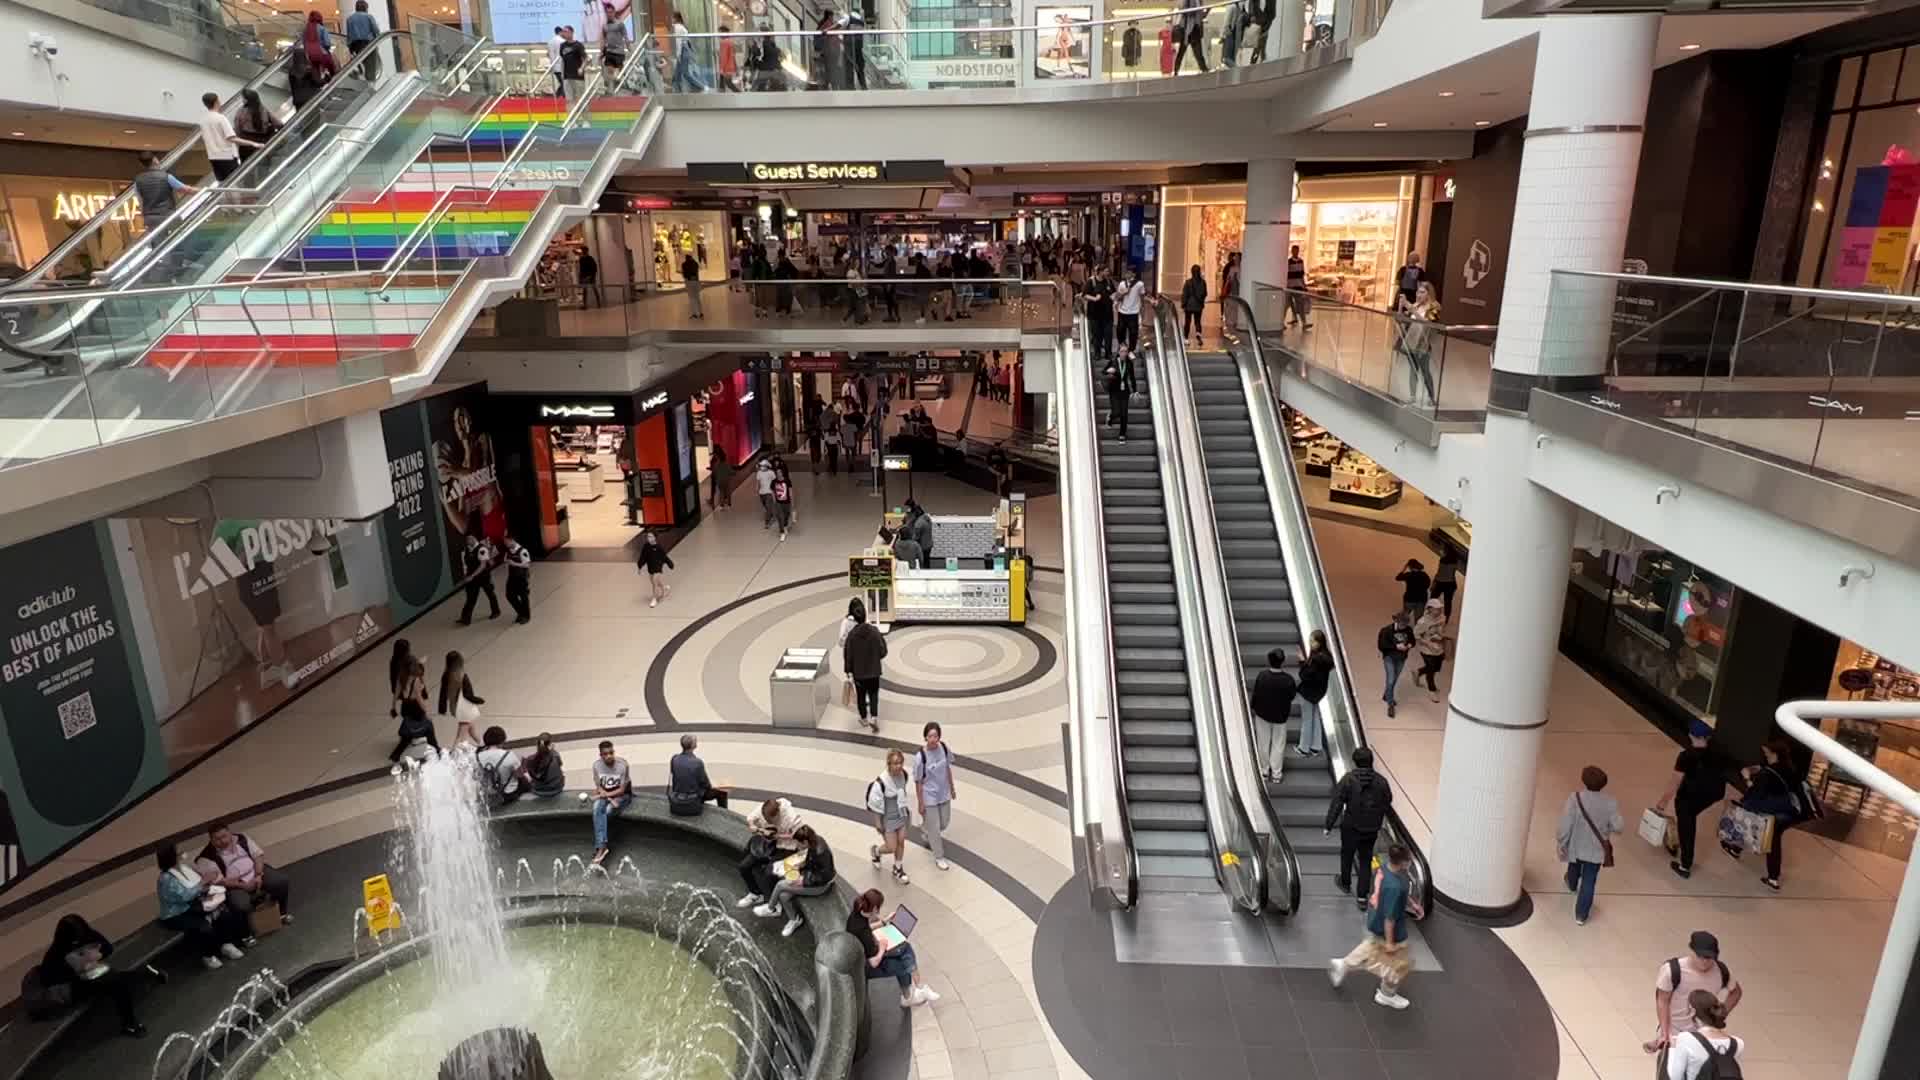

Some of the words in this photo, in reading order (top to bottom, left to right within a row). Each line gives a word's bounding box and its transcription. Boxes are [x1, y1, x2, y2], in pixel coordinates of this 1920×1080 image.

[935, 63, 1016, 77] NORDSTROM
[753, 164, 805, 180] Guest
[807, 163, 878, 180] Services
[8, 320, 20, 335] 2
[542, 404, 616, 418] MAC
[641, 391, 668, 412] MAC
[388, 450, 425, 478] PENING
[393, 472, 425, 500] PRING
[396, 493, 422, 520] 2022
[17, 585, 76, 619] adiclub
[10, 616, 70, 656] UNLOCK
[70, 604, 100, 630] THE
[2, 651, 41, 684] BEST
[43, 642, 63, 665] OF
[65, 619, 116, 656] ADIDAS
